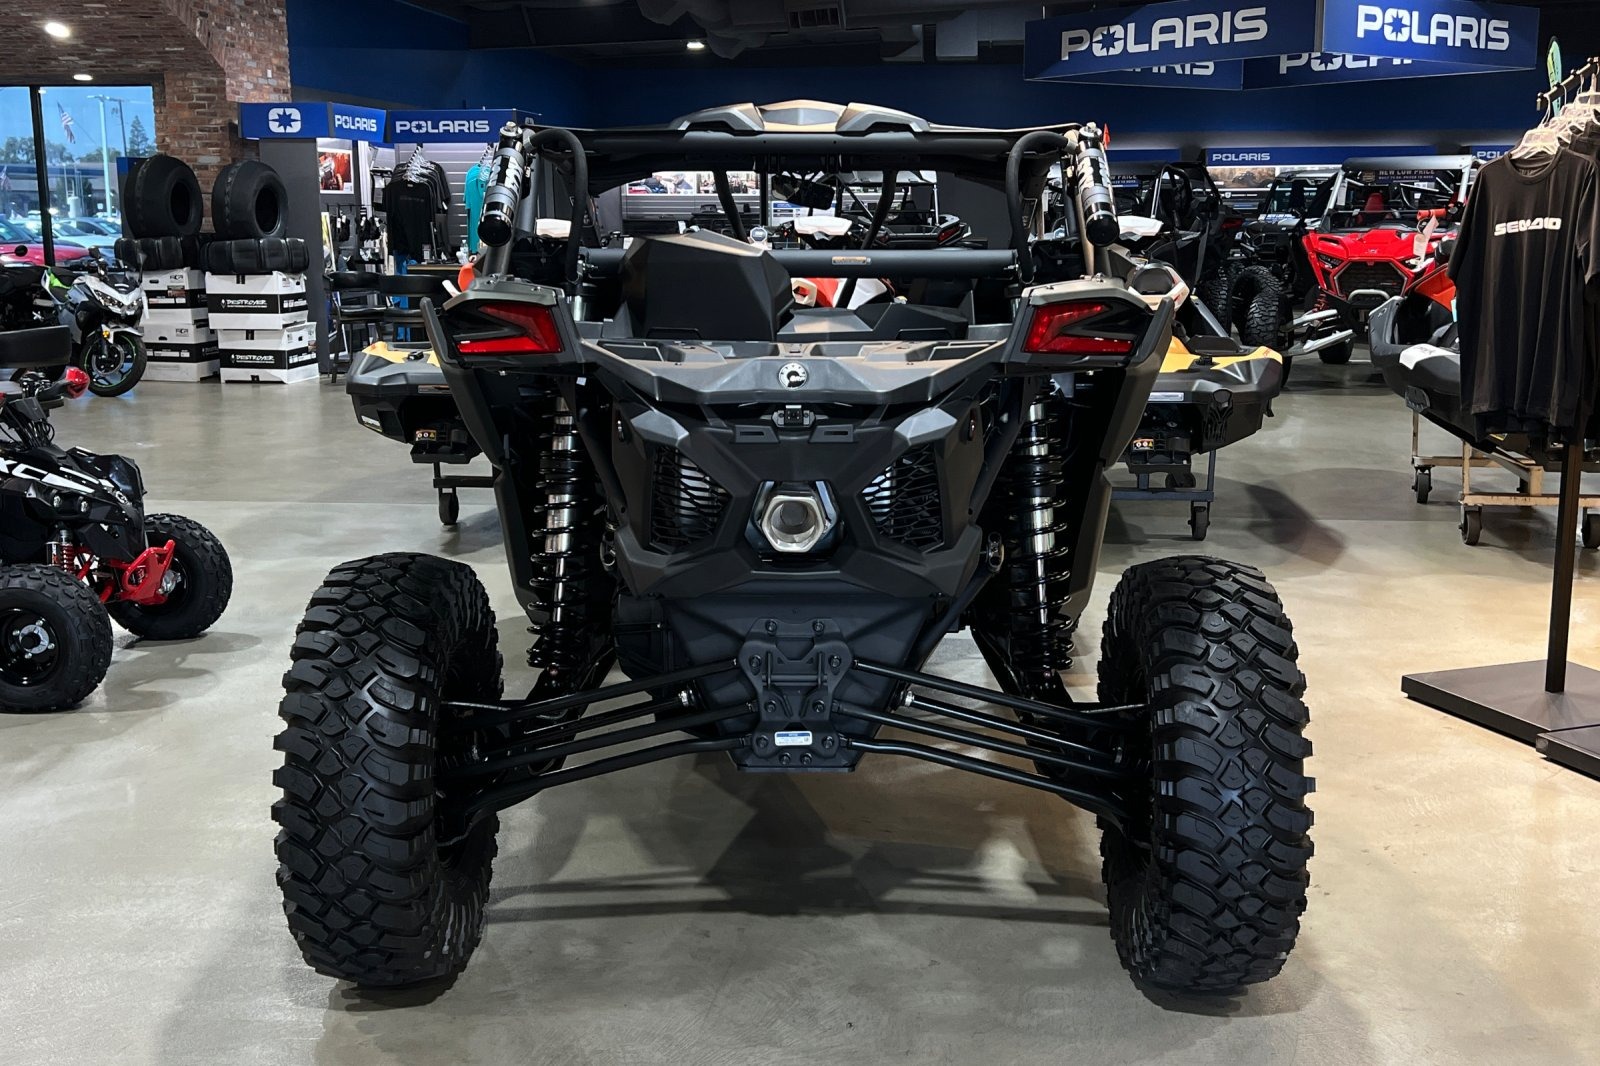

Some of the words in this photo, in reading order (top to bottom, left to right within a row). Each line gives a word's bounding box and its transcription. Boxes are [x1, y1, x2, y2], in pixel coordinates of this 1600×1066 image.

[1061, 6, 1268, 61] POLARIS
[1356, 4, 1510, 51] POLARIS
[334, 114, 378, 132] POLARIS
[395, 120, 490, 134] POLARIS
[1212, 152, 1271, 162] POLARIS
